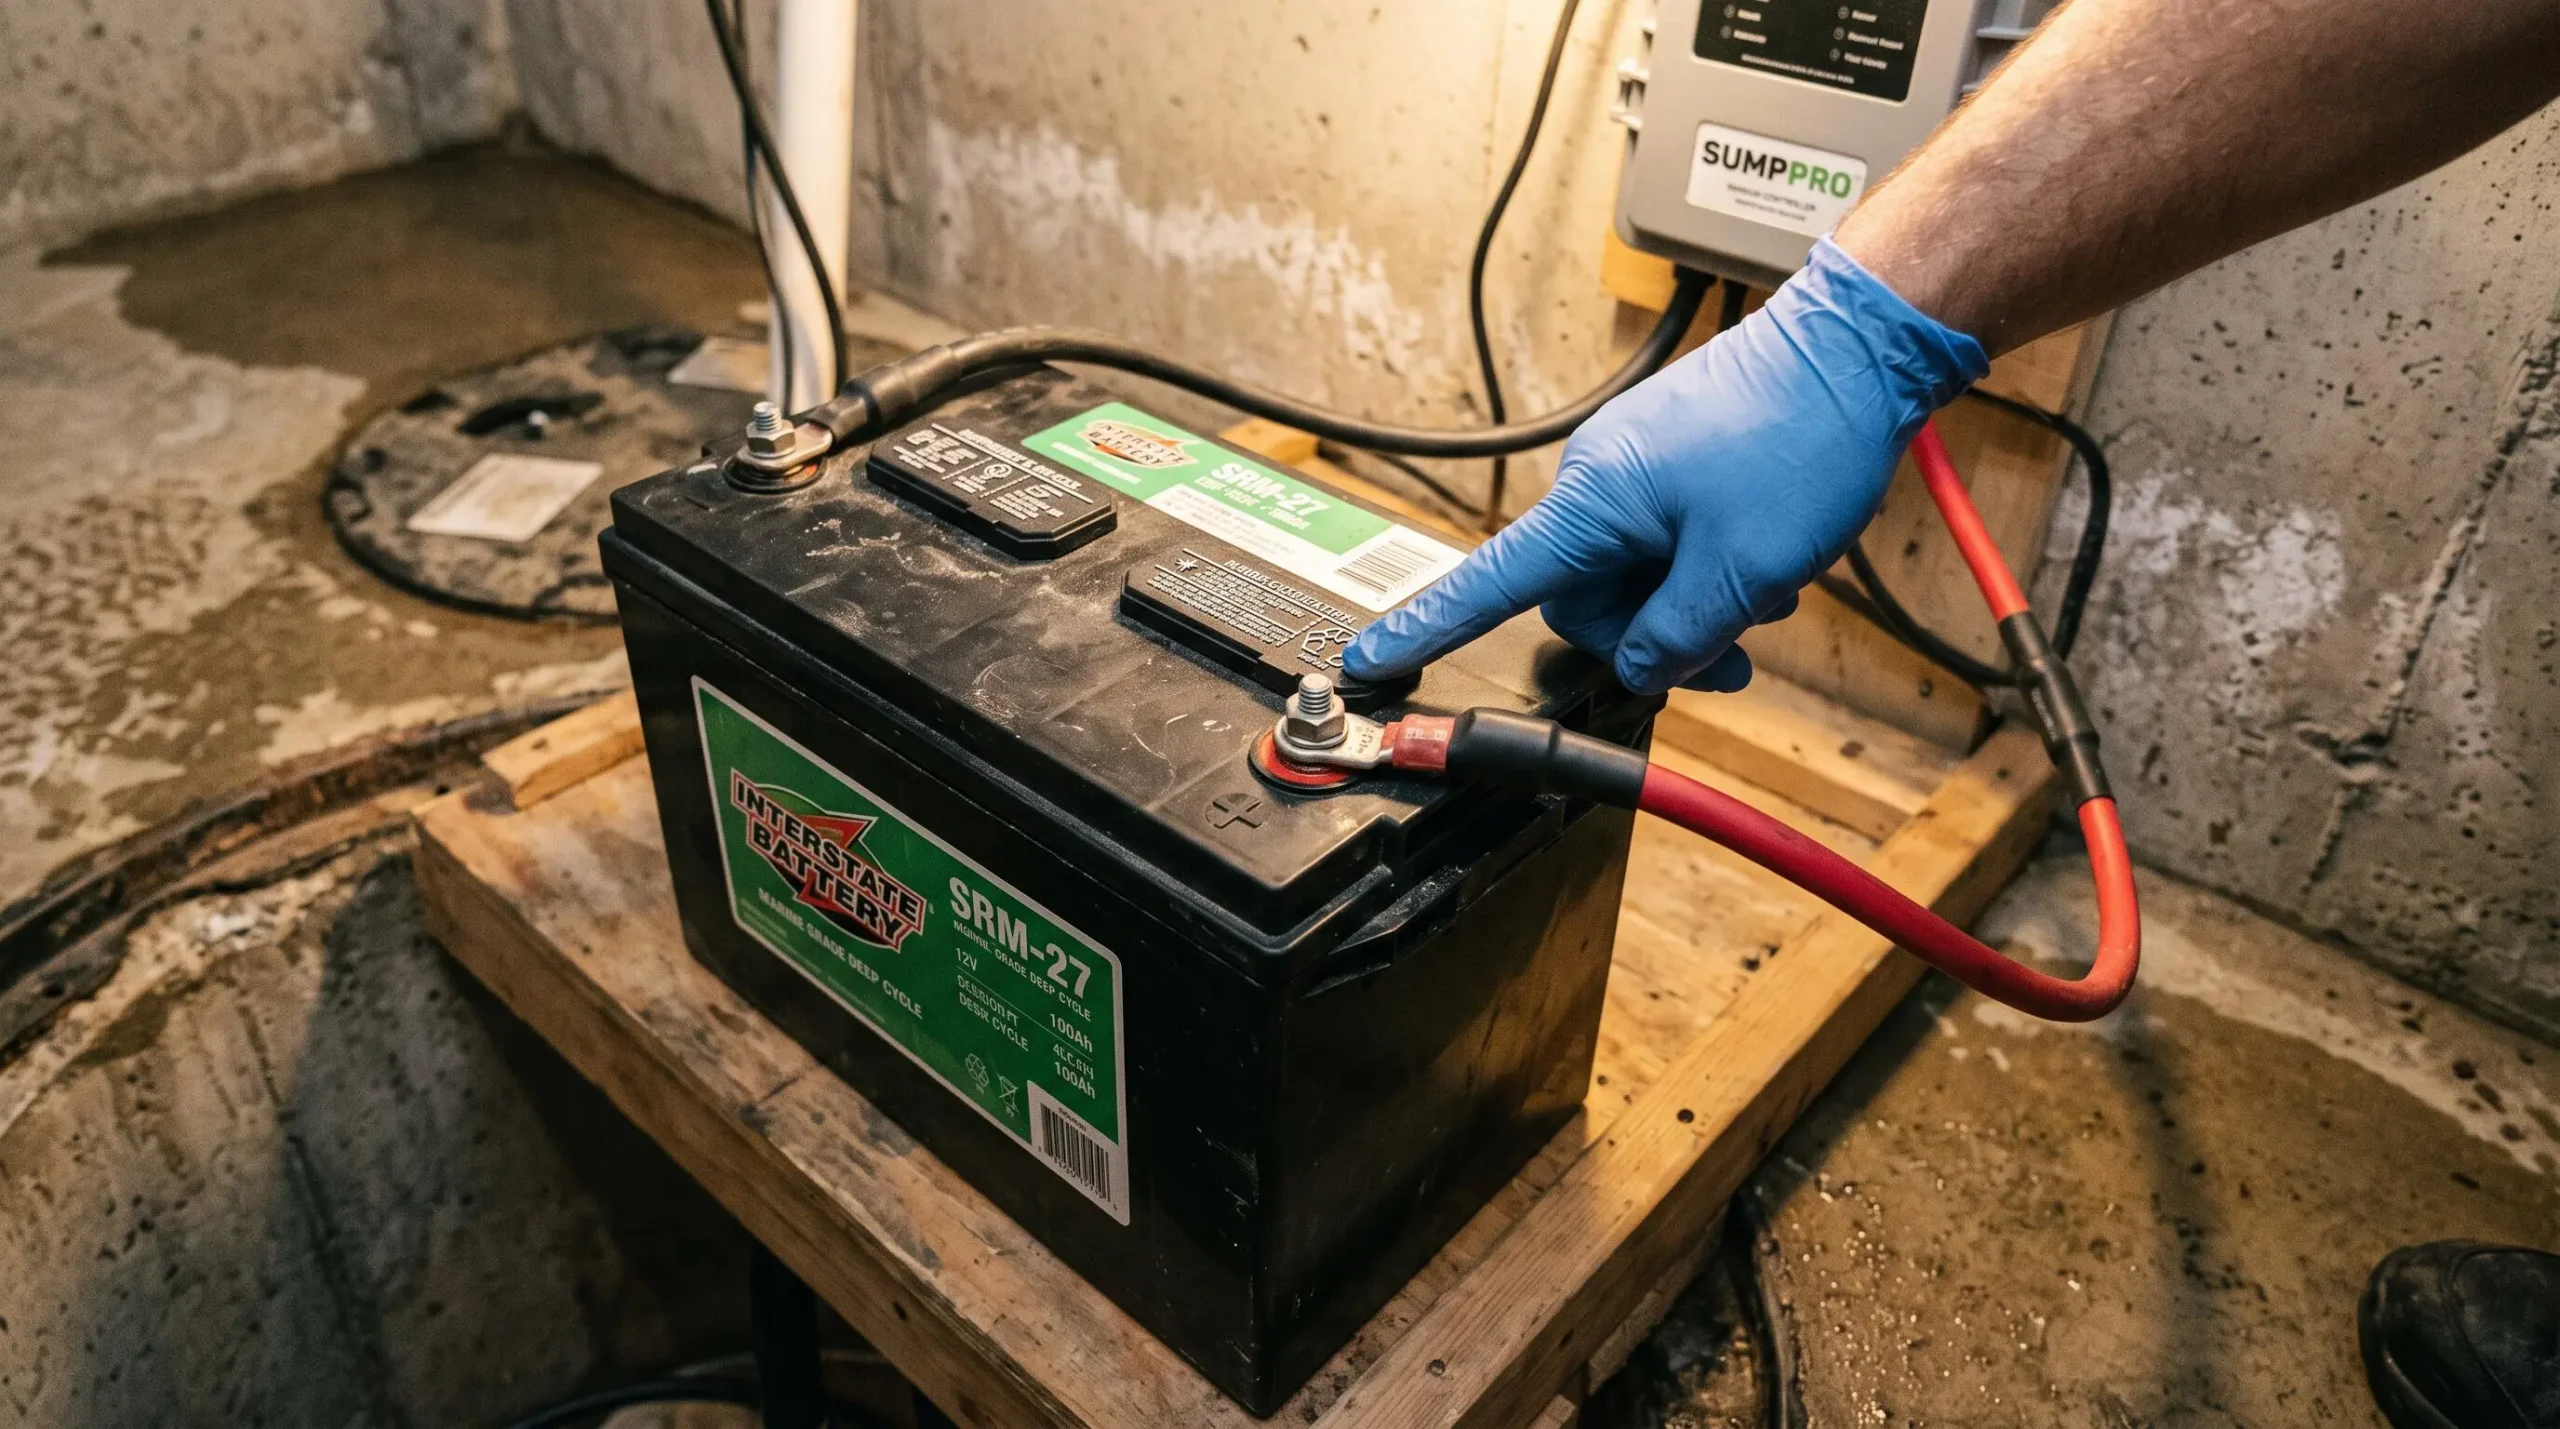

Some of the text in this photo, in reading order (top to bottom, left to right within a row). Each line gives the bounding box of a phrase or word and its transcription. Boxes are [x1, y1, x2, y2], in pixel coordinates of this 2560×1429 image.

[1211, 462, 1331, 516] SRM-27
[737, 780, 919, 924] INTERSTATE
[753, 821, 904, 944] BATTERY
[949, 876, 1092, 1000] SRM-27
[955, 947, 977, 971] 12V
[806, 923, 846, 961] GRADE
[848, 953, 879, 983] DEEP
[882, 980, 923, 1020] CYCLE
[994, 949, 1091, 1022] GRADE DEEP CYCLE
[992, 1016, 1029, 1052] CYCLE
[1049, 1013, 1093, 1053] 100Ah
[1054, 1061, 1096, 1099] 100Ah
